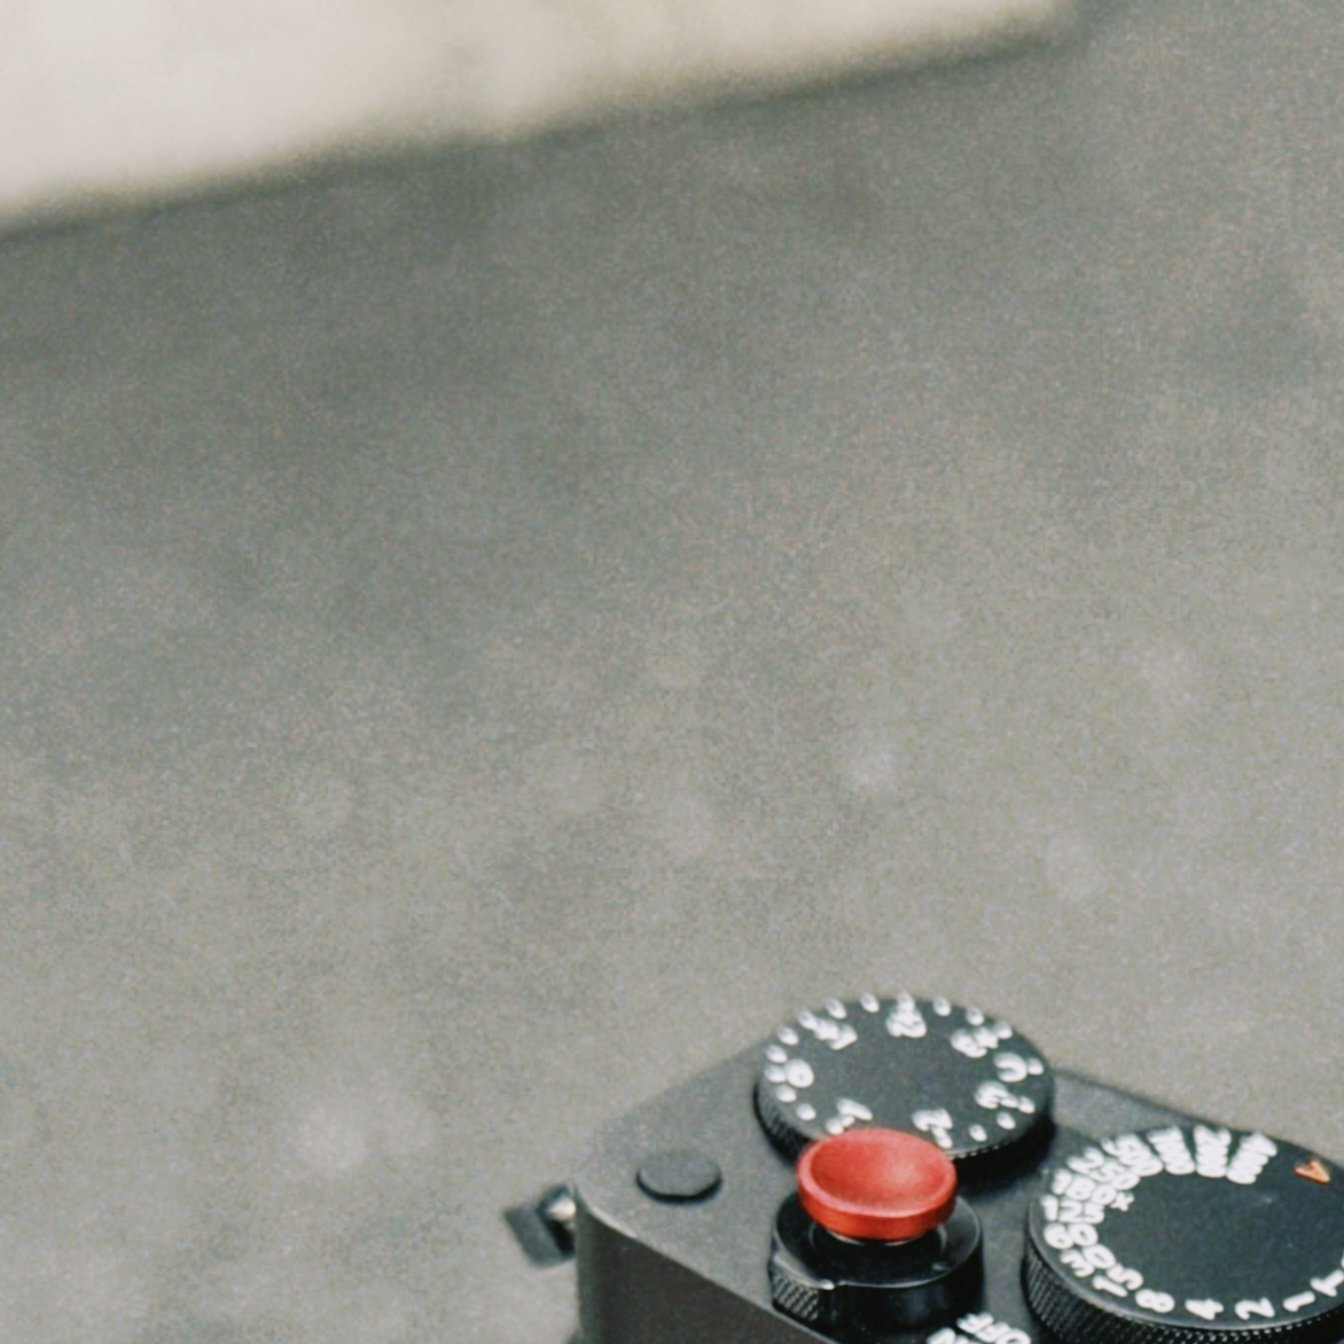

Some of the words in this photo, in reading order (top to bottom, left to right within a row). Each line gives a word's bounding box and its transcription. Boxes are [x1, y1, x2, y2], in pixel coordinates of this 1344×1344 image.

[1067, 1147, 1140, 1190] 250
[1041, 1194, 1105, 1224] 125
[1043, 1222, 1099, 1250] 60
[1059, 1245, 1116, 1278] 30
[1093, 1263, 1144, 1298] 15
[1135, 1289, 1175, 1313] 8
[1185, 1298, 1224, 1321] 4
[1234, 1297, 1275, 1320] 2
